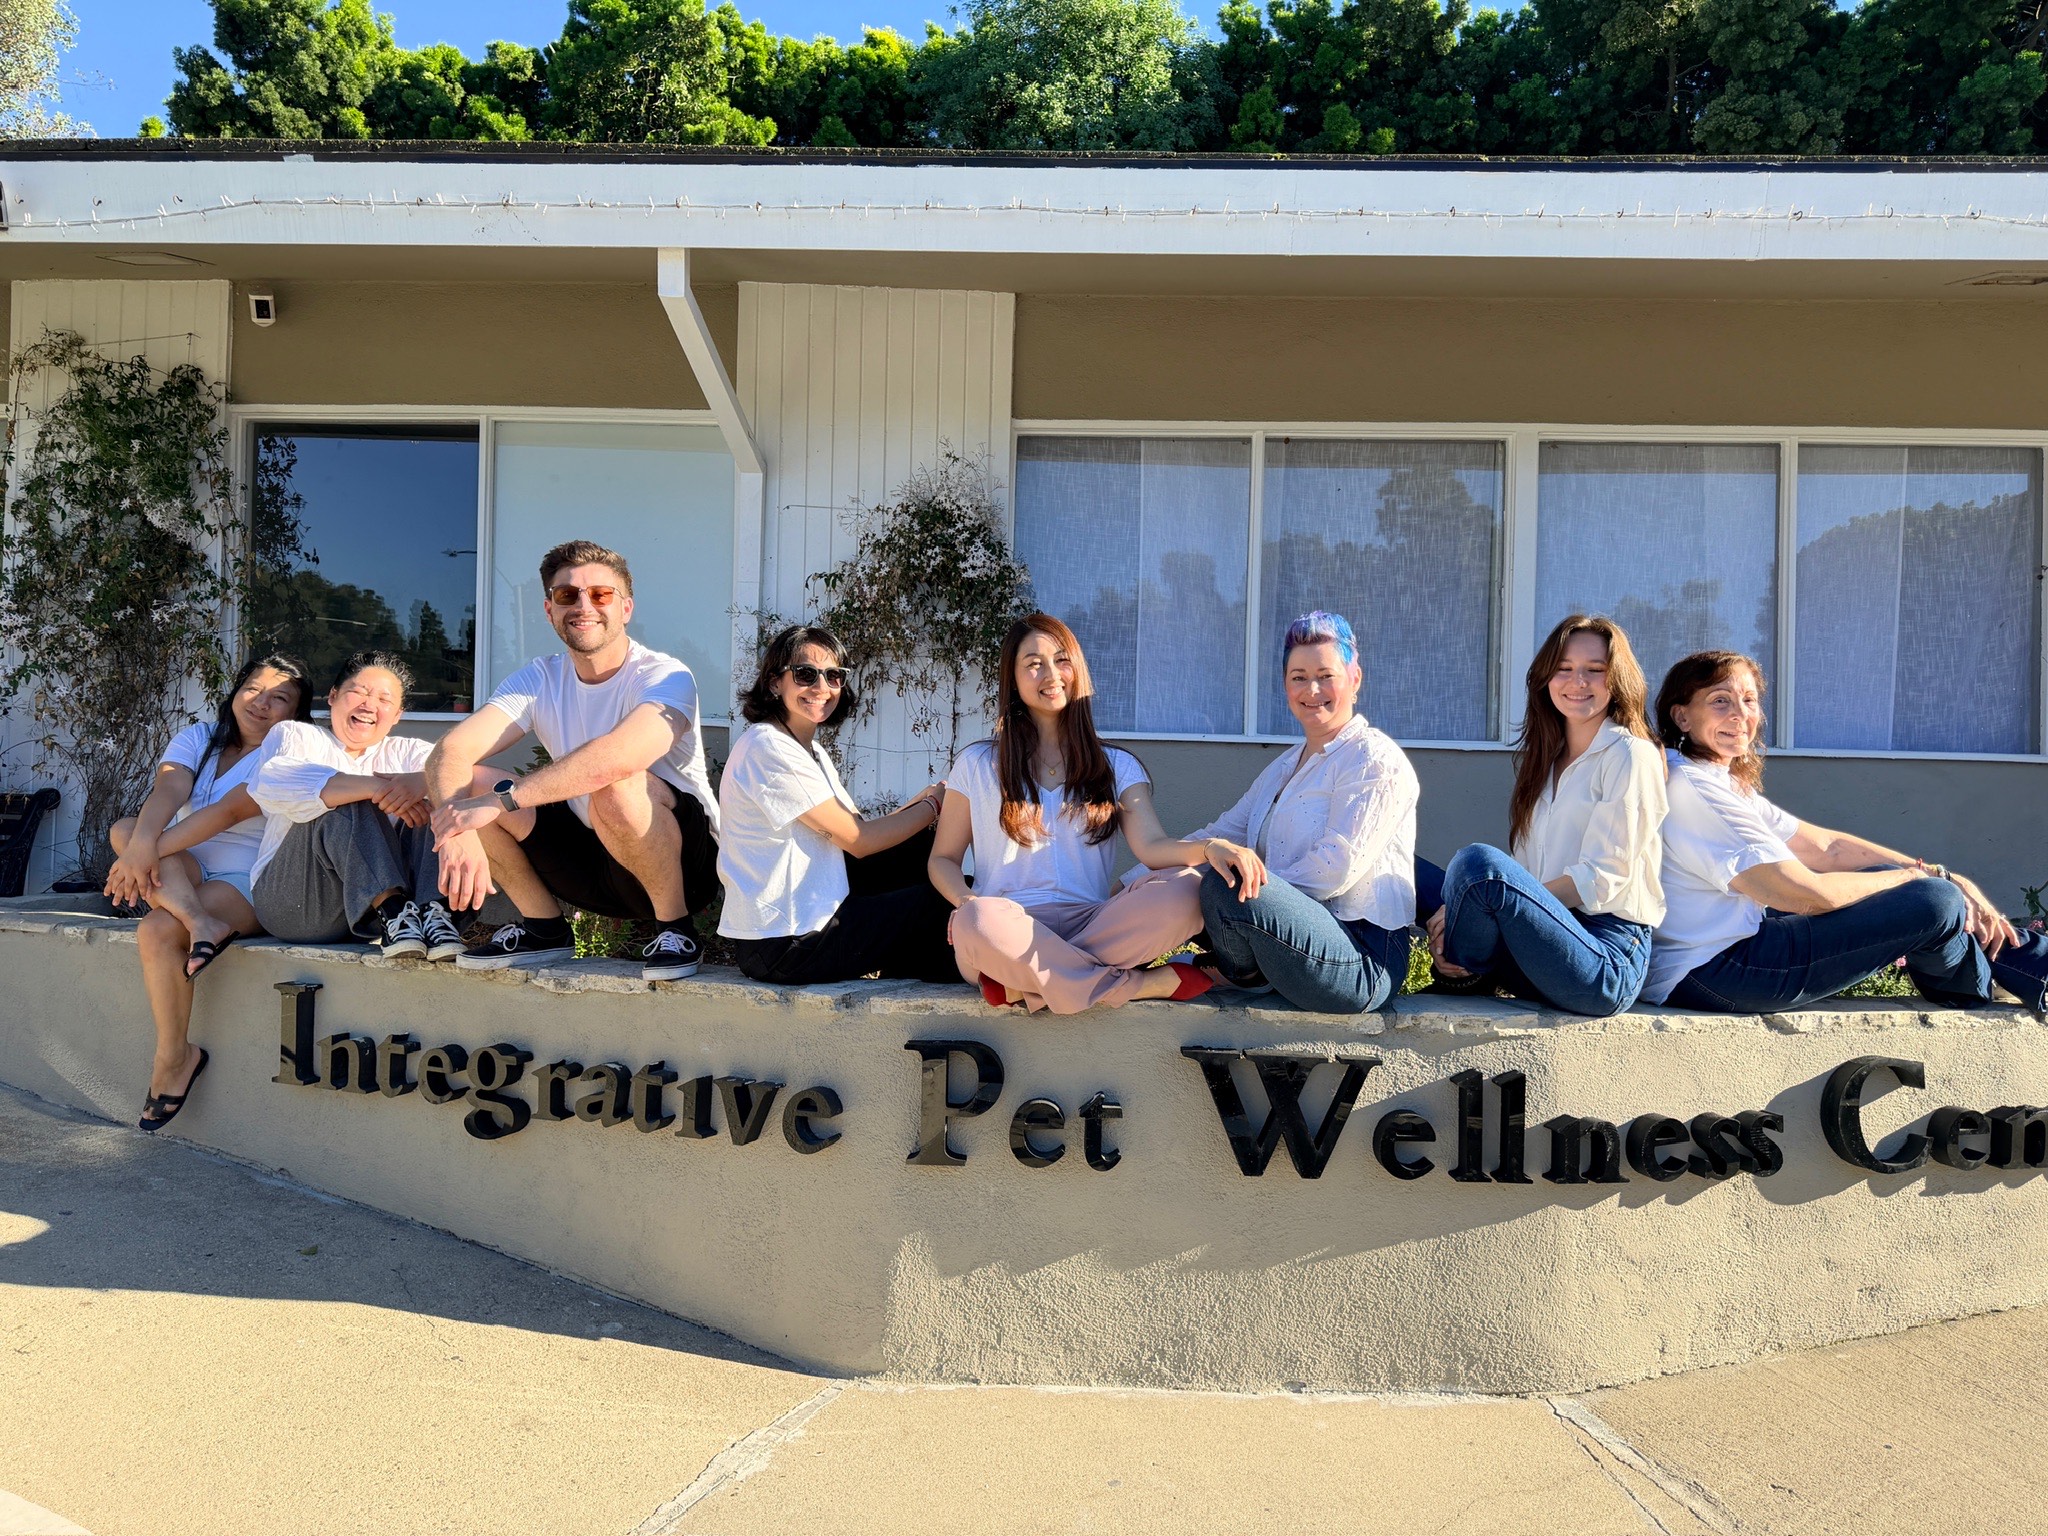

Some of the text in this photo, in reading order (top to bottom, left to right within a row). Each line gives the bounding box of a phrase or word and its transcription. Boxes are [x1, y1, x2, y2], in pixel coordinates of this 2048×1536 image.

[272, 981, 843, 1154] Integrative
[905, 1039, 1123, 1171] Pet
[1180, 1046, 1784, 1183] Wellness
